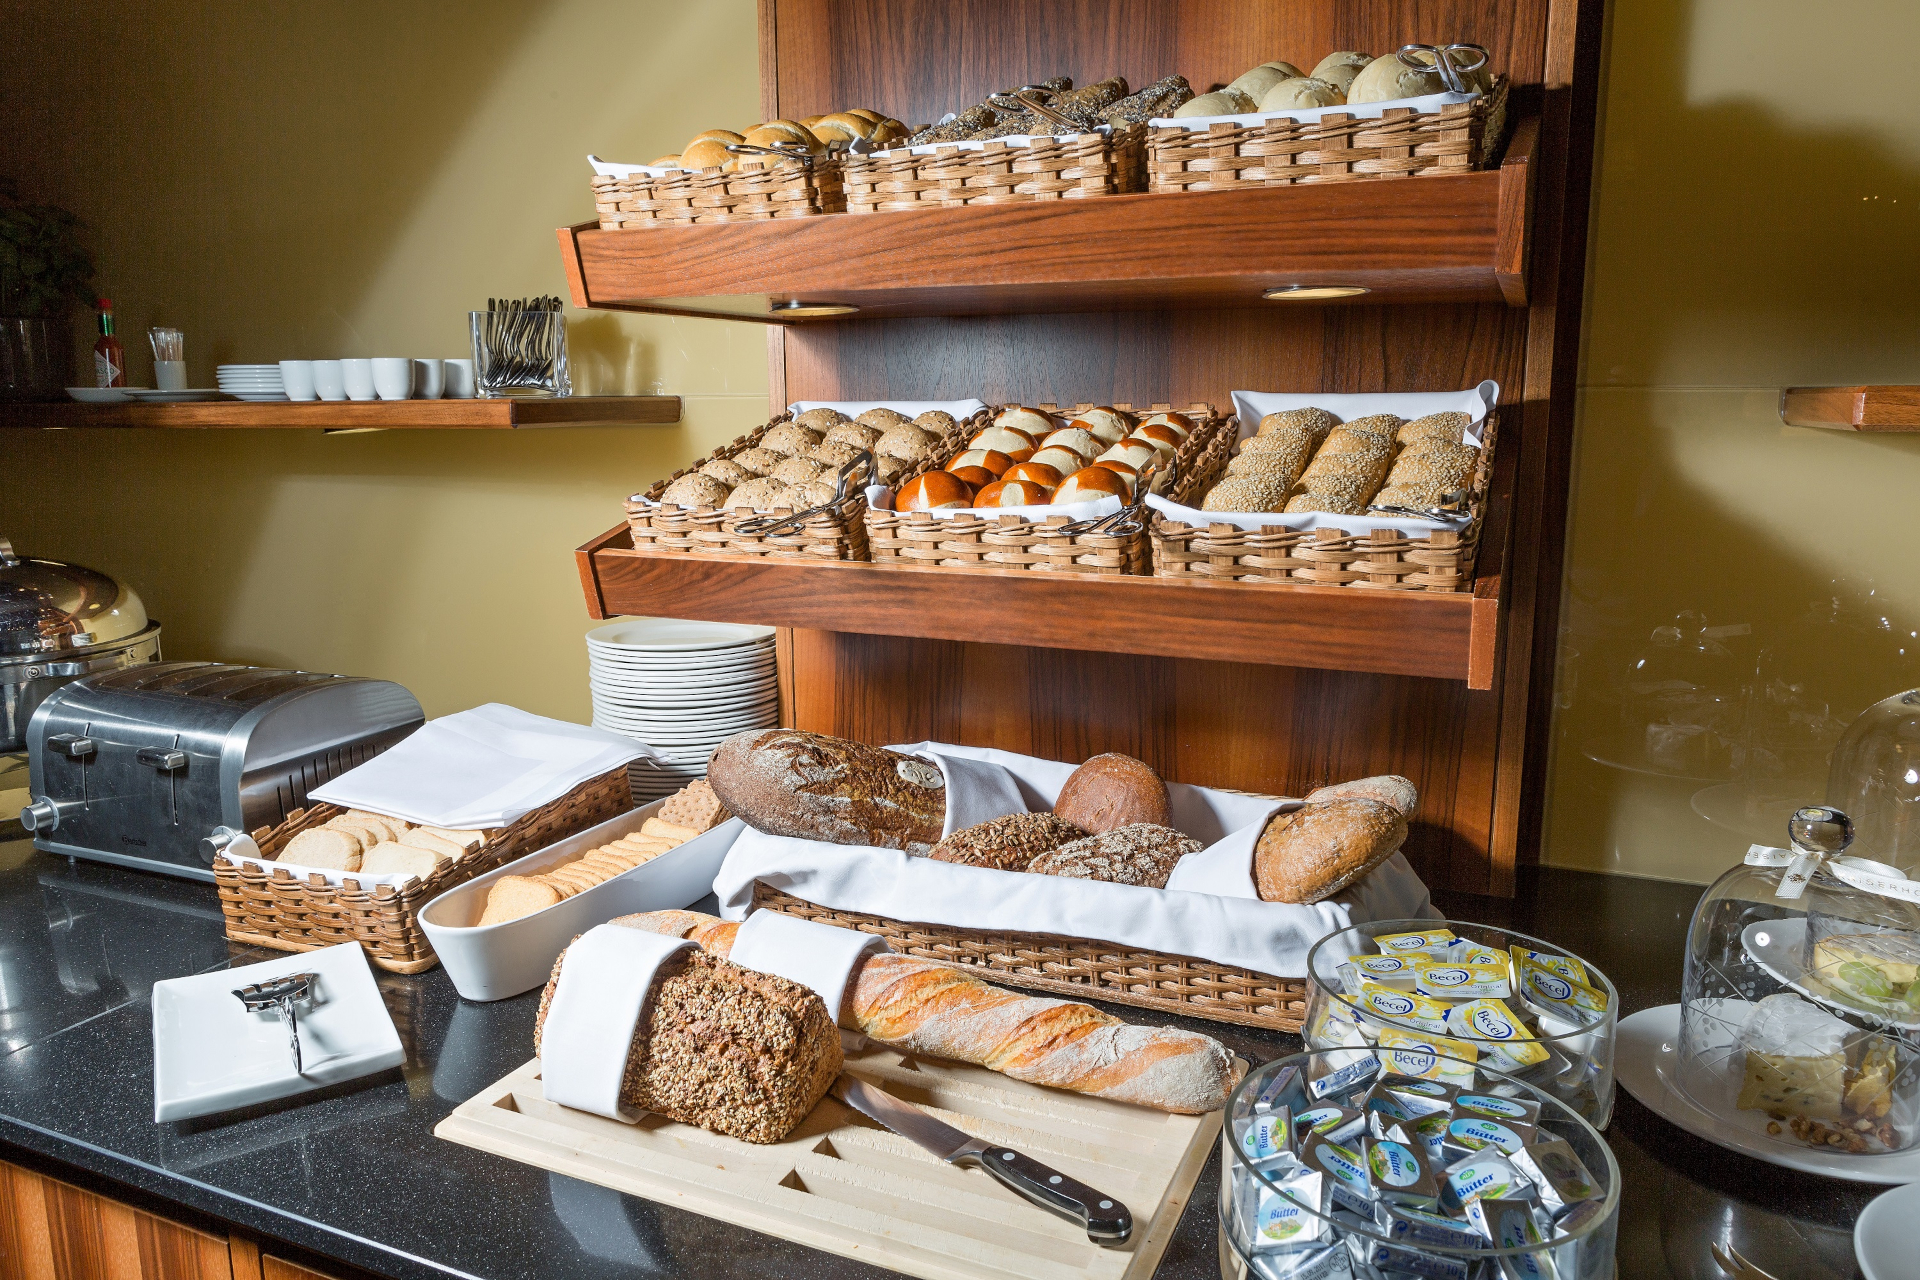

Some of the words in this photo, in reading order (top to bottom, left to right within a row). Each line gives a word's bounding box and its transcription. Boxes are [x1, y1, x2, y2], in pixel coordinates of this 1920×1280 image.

[1391, 938, 1421, 948] Becel
[1366, 959, 1399, 969] Becel
[1429, 973, 1463, 981] Becel
[1534, 974, 1565, 997] Becel
[1373, 996, 1408, 1012] Becel
[1409, 1018, 1441, 1029] Original
[1477, 1010, 1505, 1036] Becel
[1364, 1058, 1374, 1068] 10
[1394, 1051, 1430, 1067] Becel
[1472, 1100, 1513, 1111] Butter
[1260, 1125, 1268, 1150] Butter
[1465, 1127, 1508, 1143] Butter
[1389, 1150, 1401, 1178] Butter
[1456, 1173, 1494, 1198] Butter
[1358, 1201, 1369, 1211] 10
[1270, 1207, 1299, 1220] Butter
[1463, 1235, 1475, 1246] 10
[1447, 1263, 1458, 1275] 10
